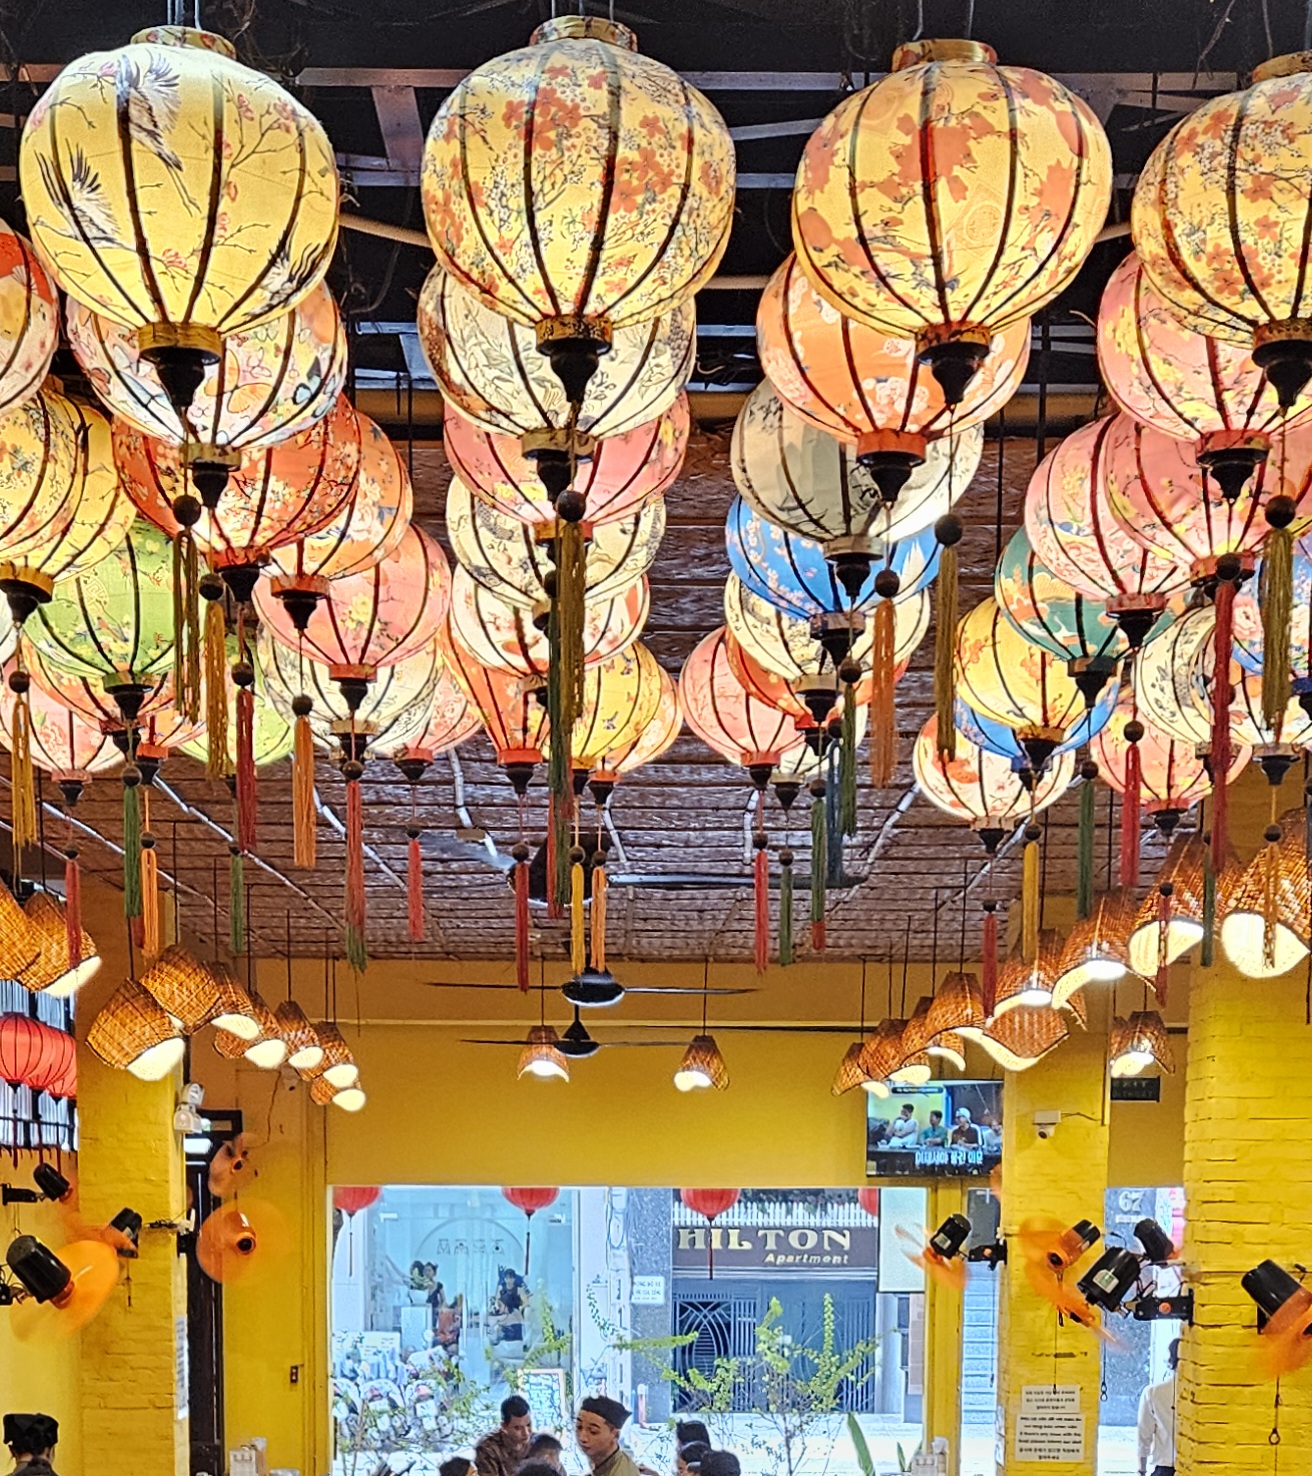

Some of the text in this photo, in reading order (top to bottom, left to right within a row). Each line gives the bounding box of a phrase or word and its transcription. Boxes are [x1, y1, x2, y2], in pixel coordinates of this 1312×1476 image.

[1118, 1190, 1144, 1212] 67
[678, 1228, 851, 1250] HILTON
[765, 1253, 849, 1265] Apartment
